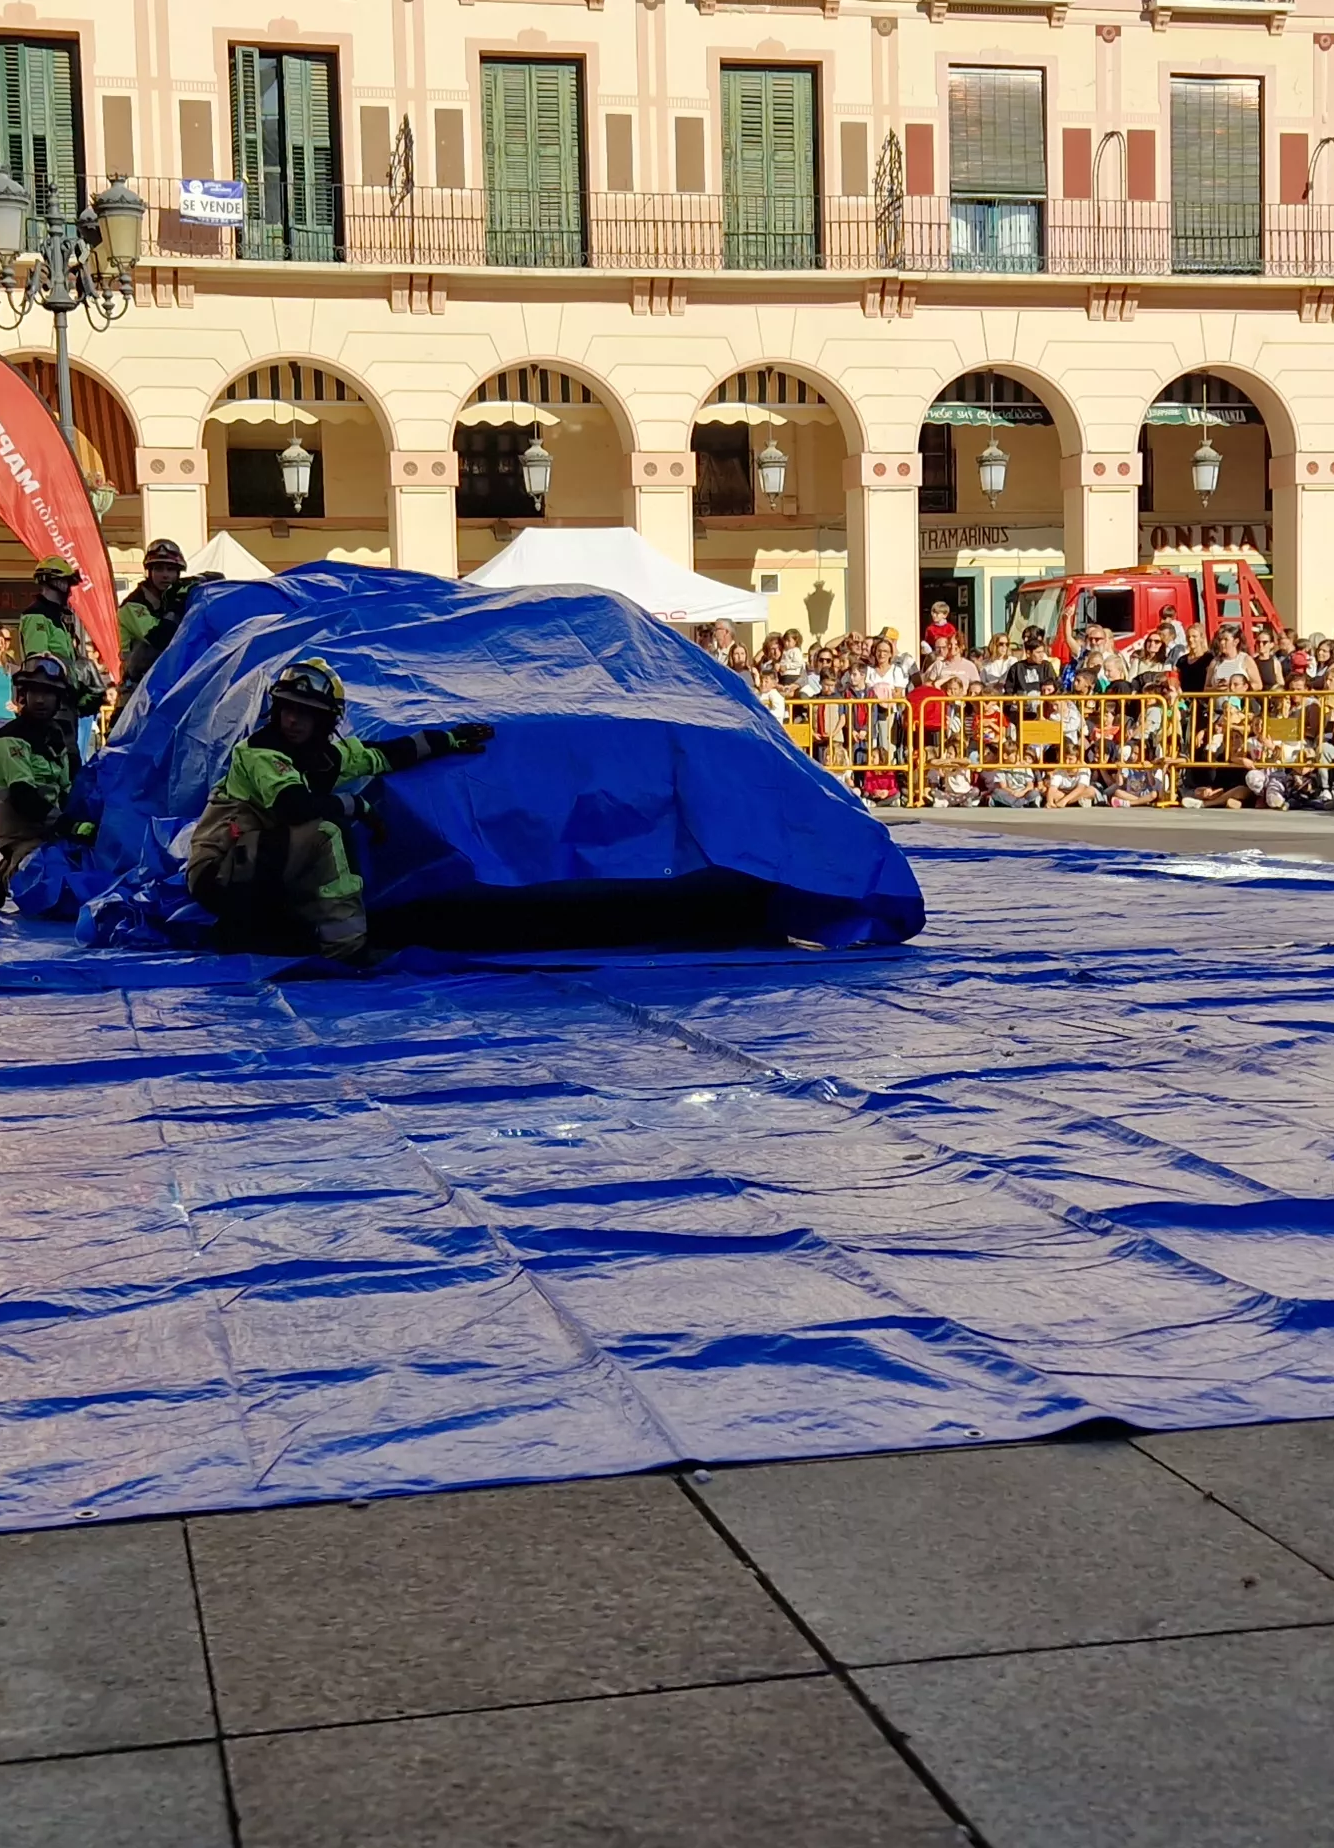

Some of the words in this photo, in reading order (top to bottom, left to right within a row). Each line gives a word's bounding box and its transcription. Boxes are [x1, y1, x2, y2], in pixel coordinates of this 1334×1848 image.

[183, 199, 196, 211] SE
[200, 200, 241, 214] VENDE
[920, 527, 1009, 550] TRAMARINOS
